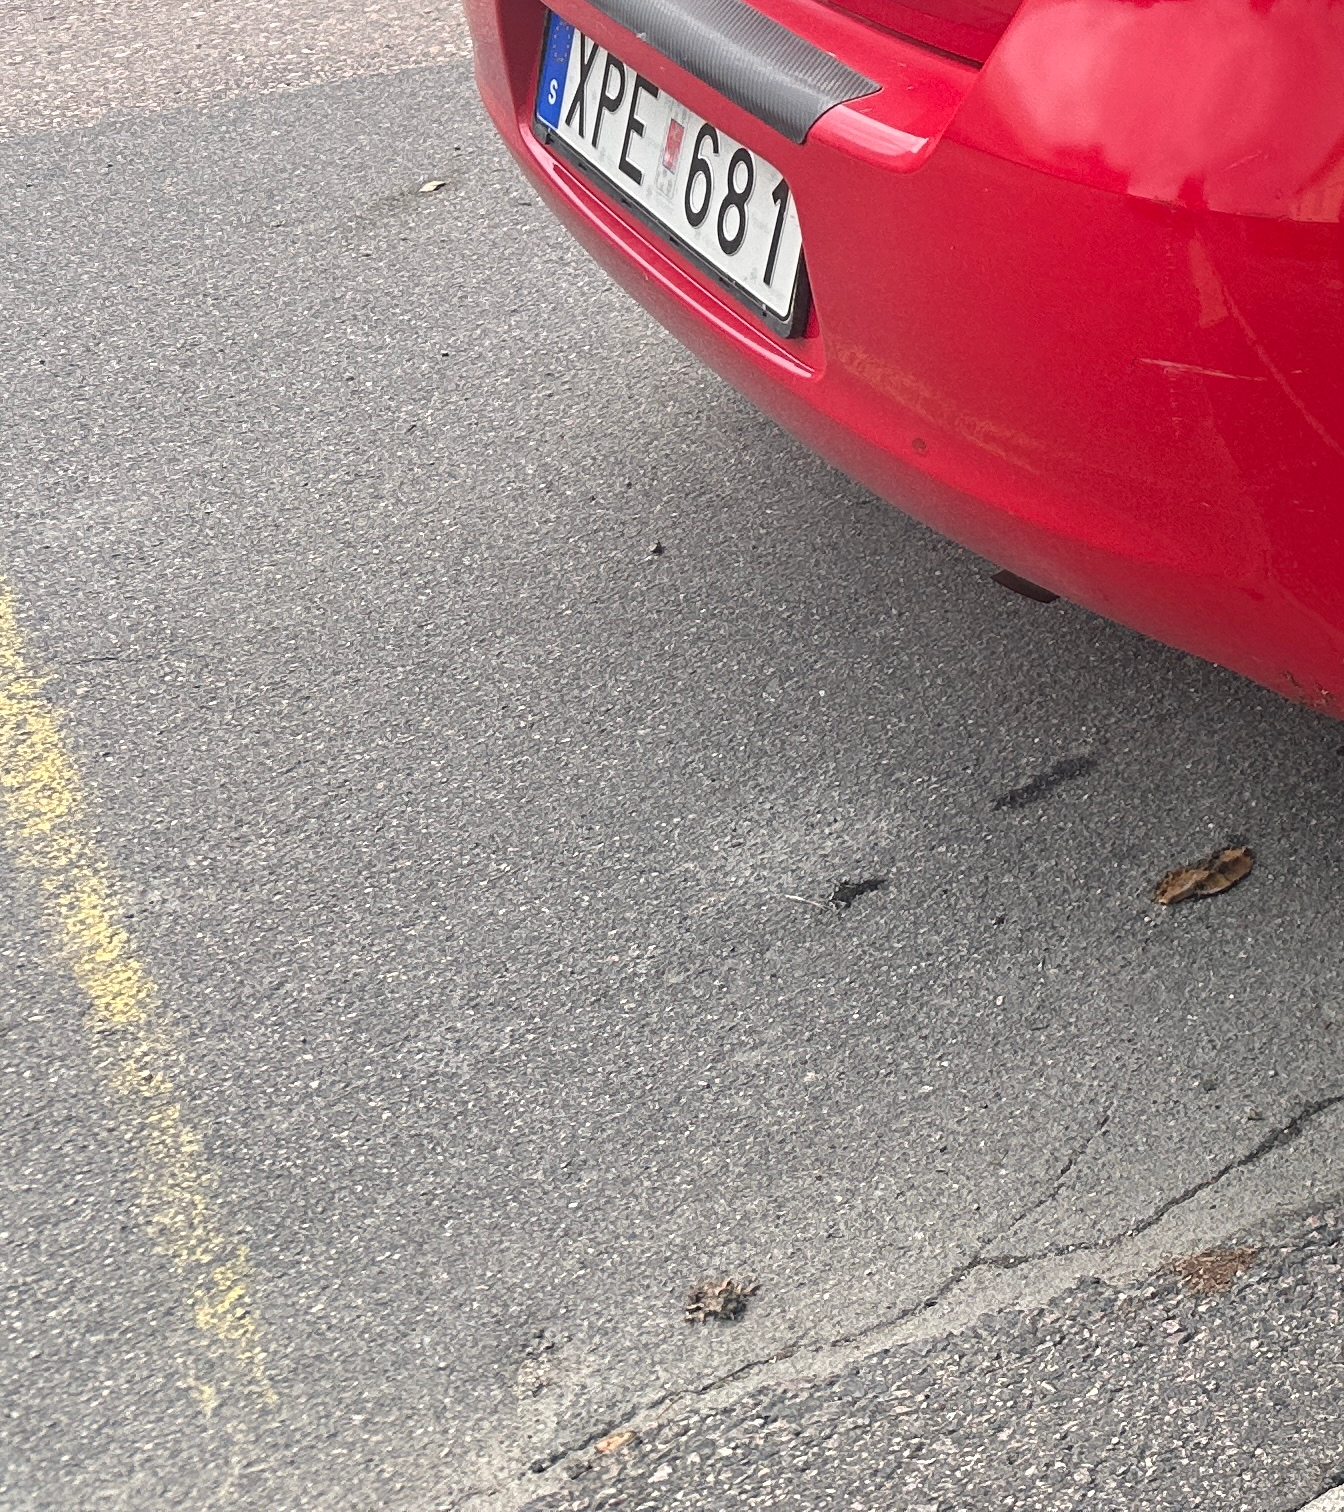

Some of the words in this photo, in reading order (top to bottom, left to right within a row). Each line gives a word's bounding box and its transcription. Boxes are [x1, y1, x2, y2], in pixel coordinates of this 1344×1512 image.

[548, 78, 559, 105] S
[565, 32, 659, 186] XPE
[685, 122, 790, 286] 681
